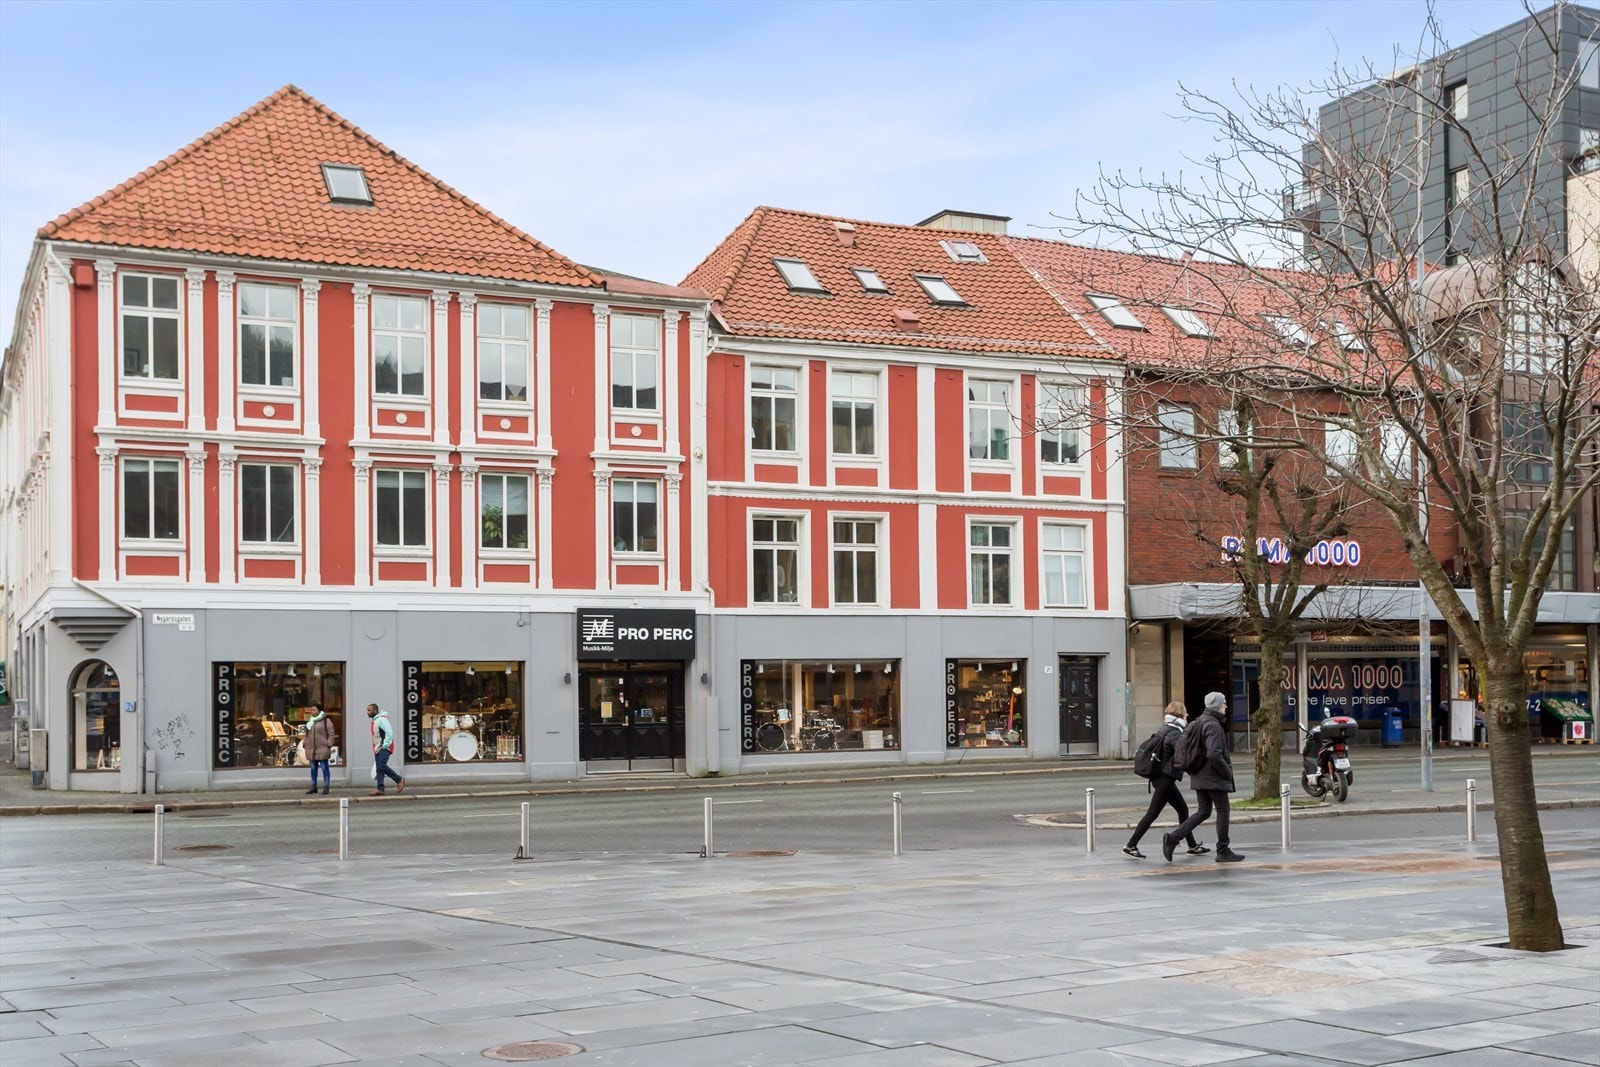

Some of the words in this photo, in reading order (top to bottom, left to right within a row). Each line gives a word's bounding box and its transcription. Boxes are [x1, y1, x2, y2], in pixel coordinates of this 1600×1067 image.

[1221, 536, 1292, 563] RM
[618, 627, 649, 640] PRO
[653, 628, 694, 641] PERC
[217, 665, 231, 705] PRO
[407, 666, 419, 704] PRO
[742, 663, 753, 698] PRO
[946, 662, 956, 696] PRO
[1280, 665, 1346, 690] RMA
[1351, 665, 1403, 690] 1000
[1287, 695, 1319, 706] bre
[1322, 694, 1348, 706] lave
[1351, 693, 1391, 707] priser
[218, 710, 230, 763] PERC
[408, 709, 419, 760] PERC
[743, 703, 753, 750] PERC
[947, 700, 956, 744] PERC
